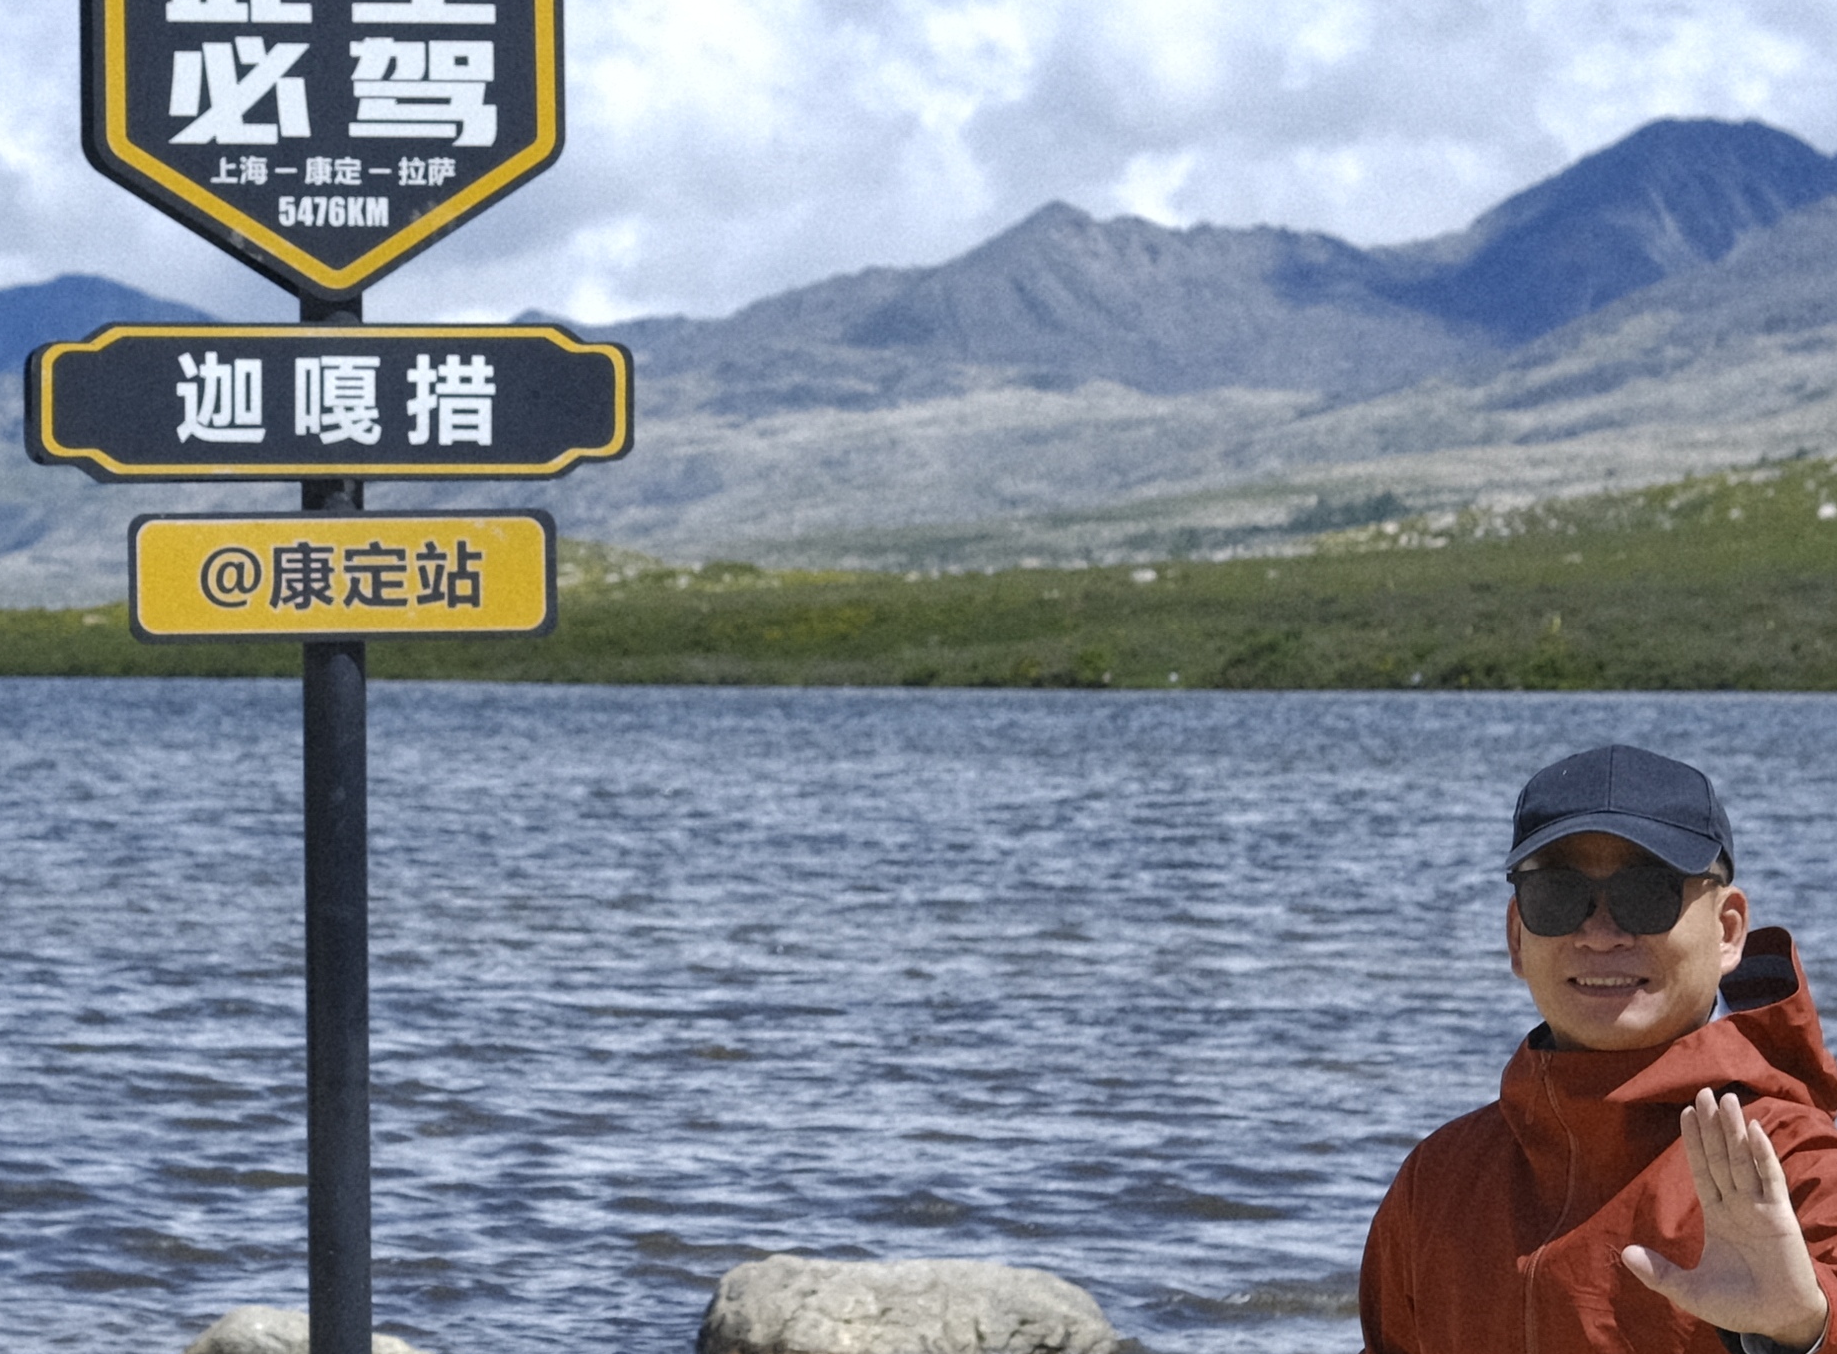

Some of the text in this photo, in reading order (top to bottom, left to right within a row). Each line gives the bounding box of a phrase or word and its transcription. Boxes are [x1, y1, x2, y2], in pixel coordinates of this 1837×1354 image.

[168, 36, 497, 146] 必驾
[278, 196, 389, 227] 5476KM
[176, 351, 496, 446] 迦嘎措
[201, 541, 483, 610] @康定站
